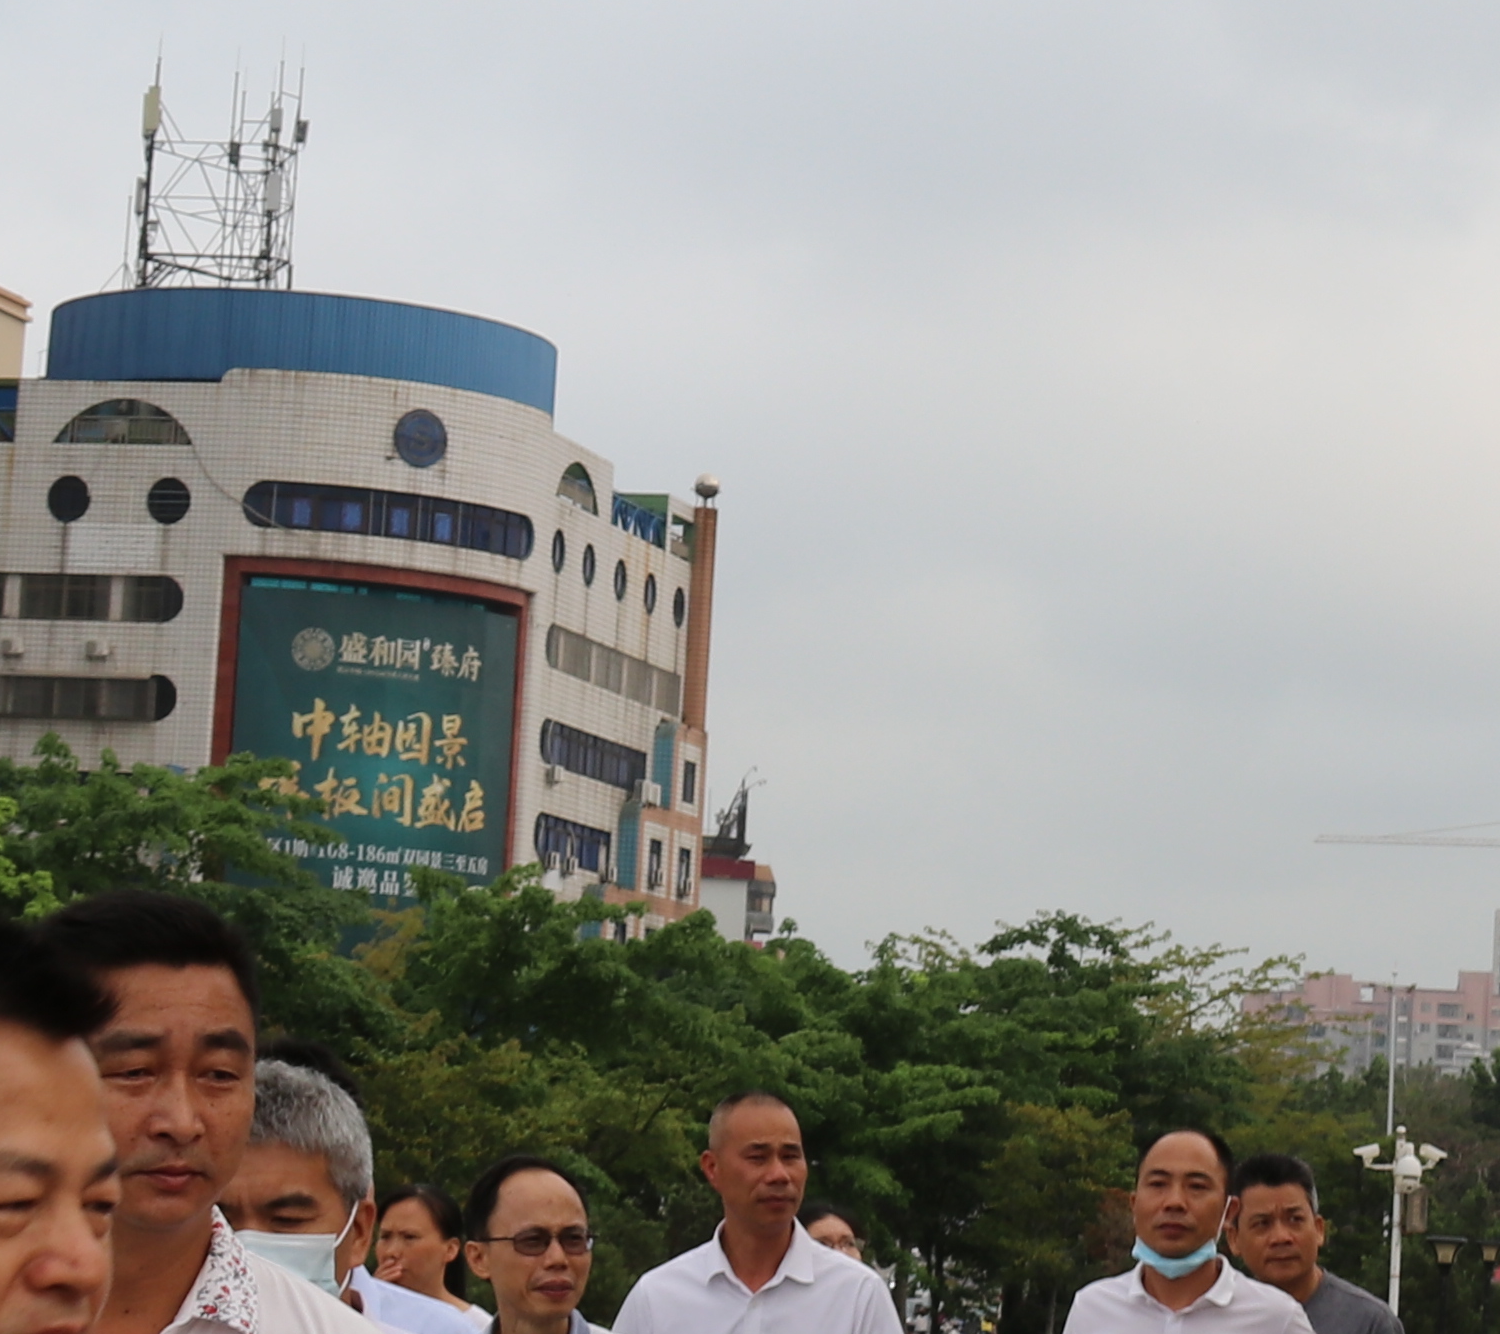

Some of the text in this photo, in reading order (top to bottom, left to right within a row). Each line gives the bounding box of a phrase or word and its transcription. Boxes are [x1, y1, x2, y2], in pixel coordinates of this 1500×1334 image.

[338, 632, 421, 671] 盛和园
[430, 642, 483, 683] 臻府
